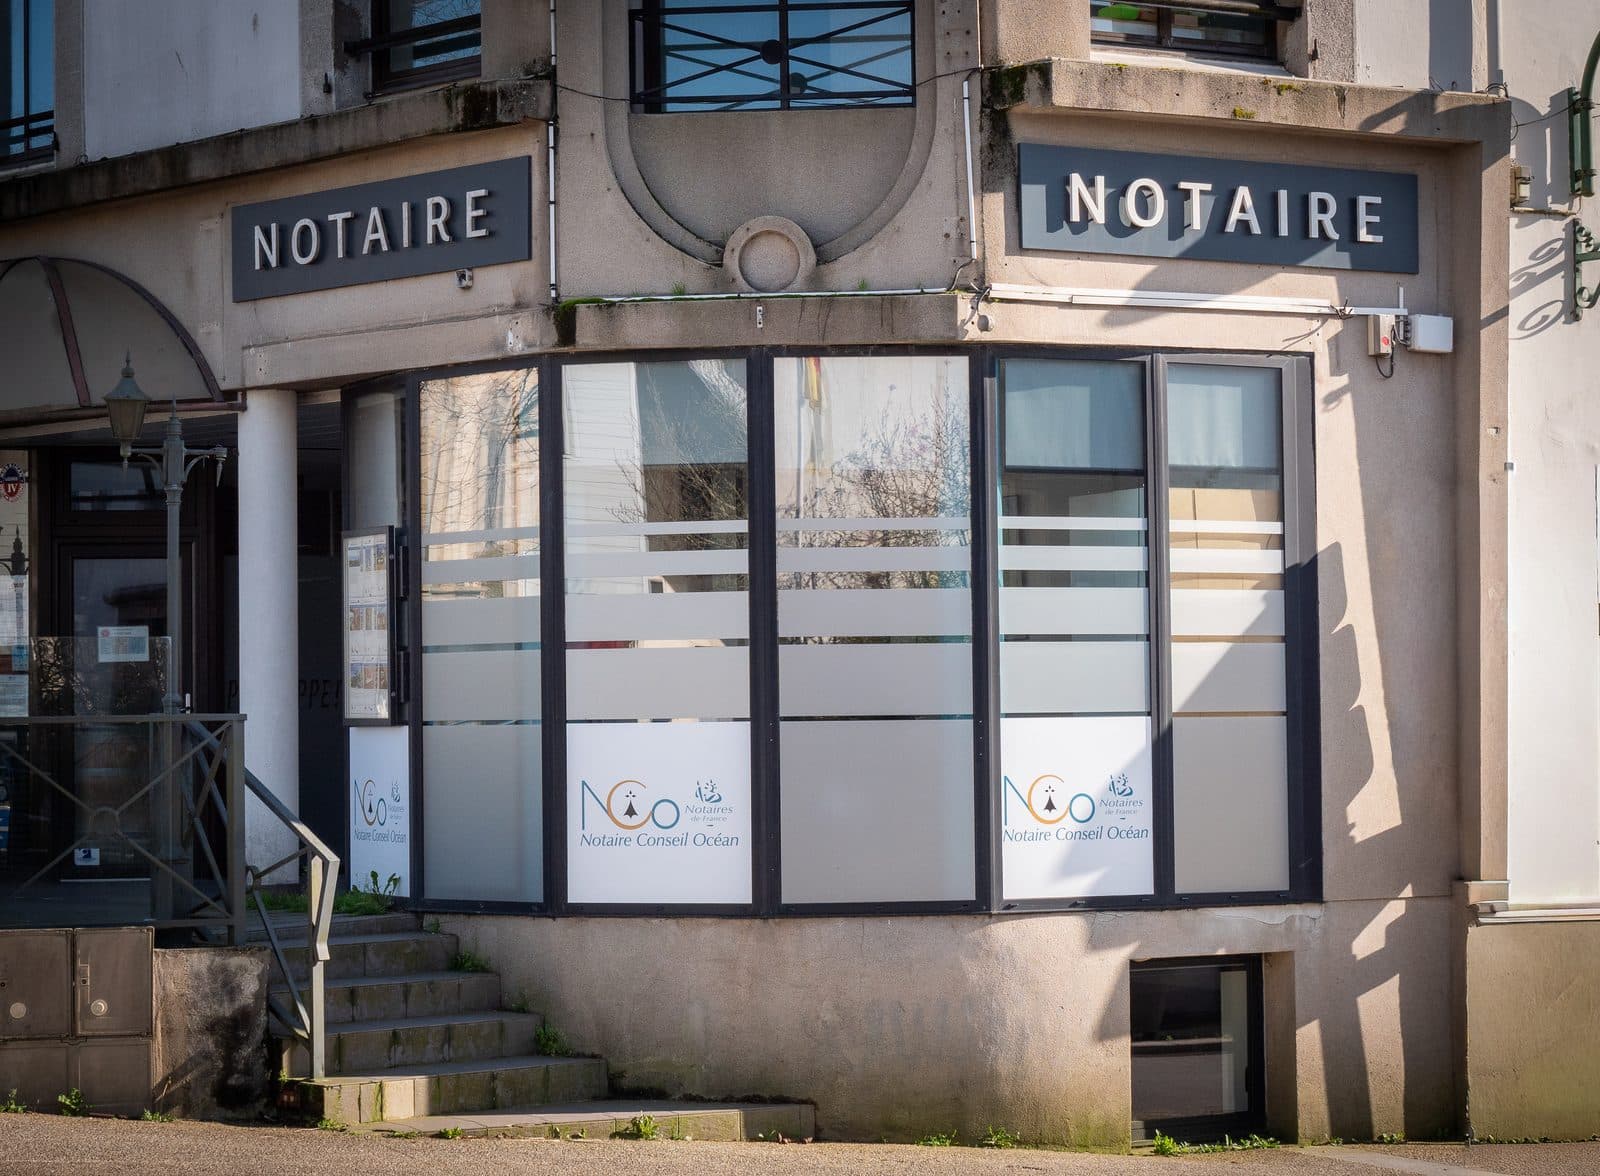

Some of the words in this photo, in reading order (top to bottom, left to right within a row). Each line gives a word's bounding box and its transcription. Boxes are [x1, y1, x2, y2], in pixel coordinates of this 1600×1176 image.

[1068, 172, 1384, 244] NOTAIRE
[253, 188, 490, 270] NOTAIRE
[685, 804, 735, 814] Notaires
[1099, 798, 1145, 808] Notaires
[580, 833, 632, 847] Notaire
[636, 832, 689, 847] Conseil
[692, 832, 739, 847] Océan
[1003, 828, 1052, 842] Notaire
[1055, 826, 1104, 841] Conseil
[1107, 825, 1149, 840] Océan
